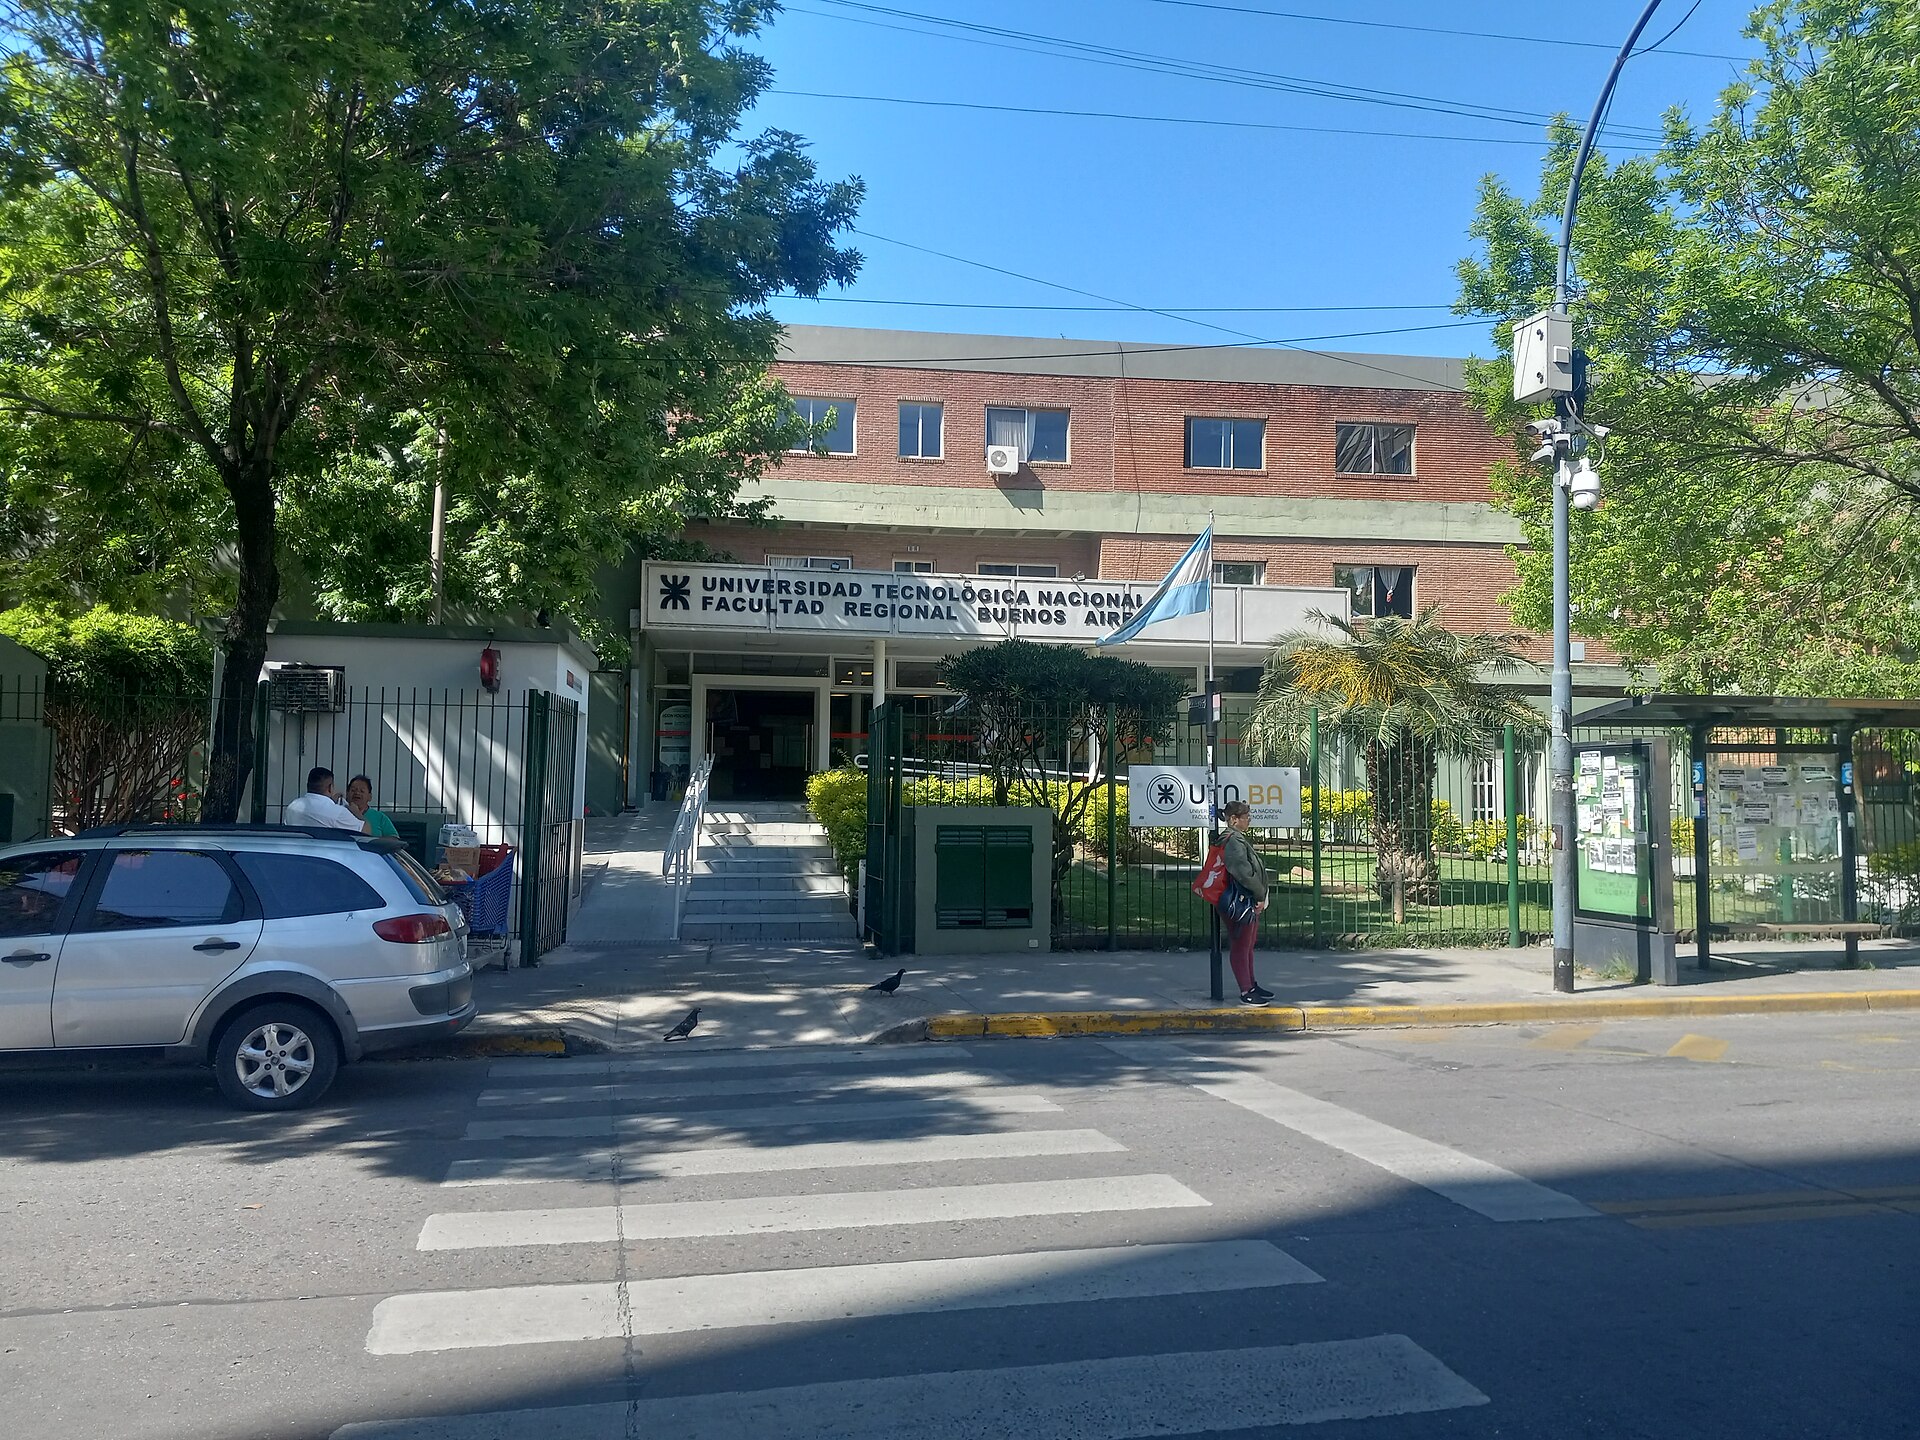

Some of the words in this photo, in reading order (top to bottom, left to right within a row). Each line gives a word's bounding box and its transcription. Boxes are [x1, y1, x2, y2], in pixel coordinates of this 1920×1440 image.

[702, 575, 863, 599] UNIVERSIDAD
[701, 596, 825, 615] FACULTAD
[844, 601, 958, 621] REGIONAL
[977, 608, 1067, 626] BUENOS
